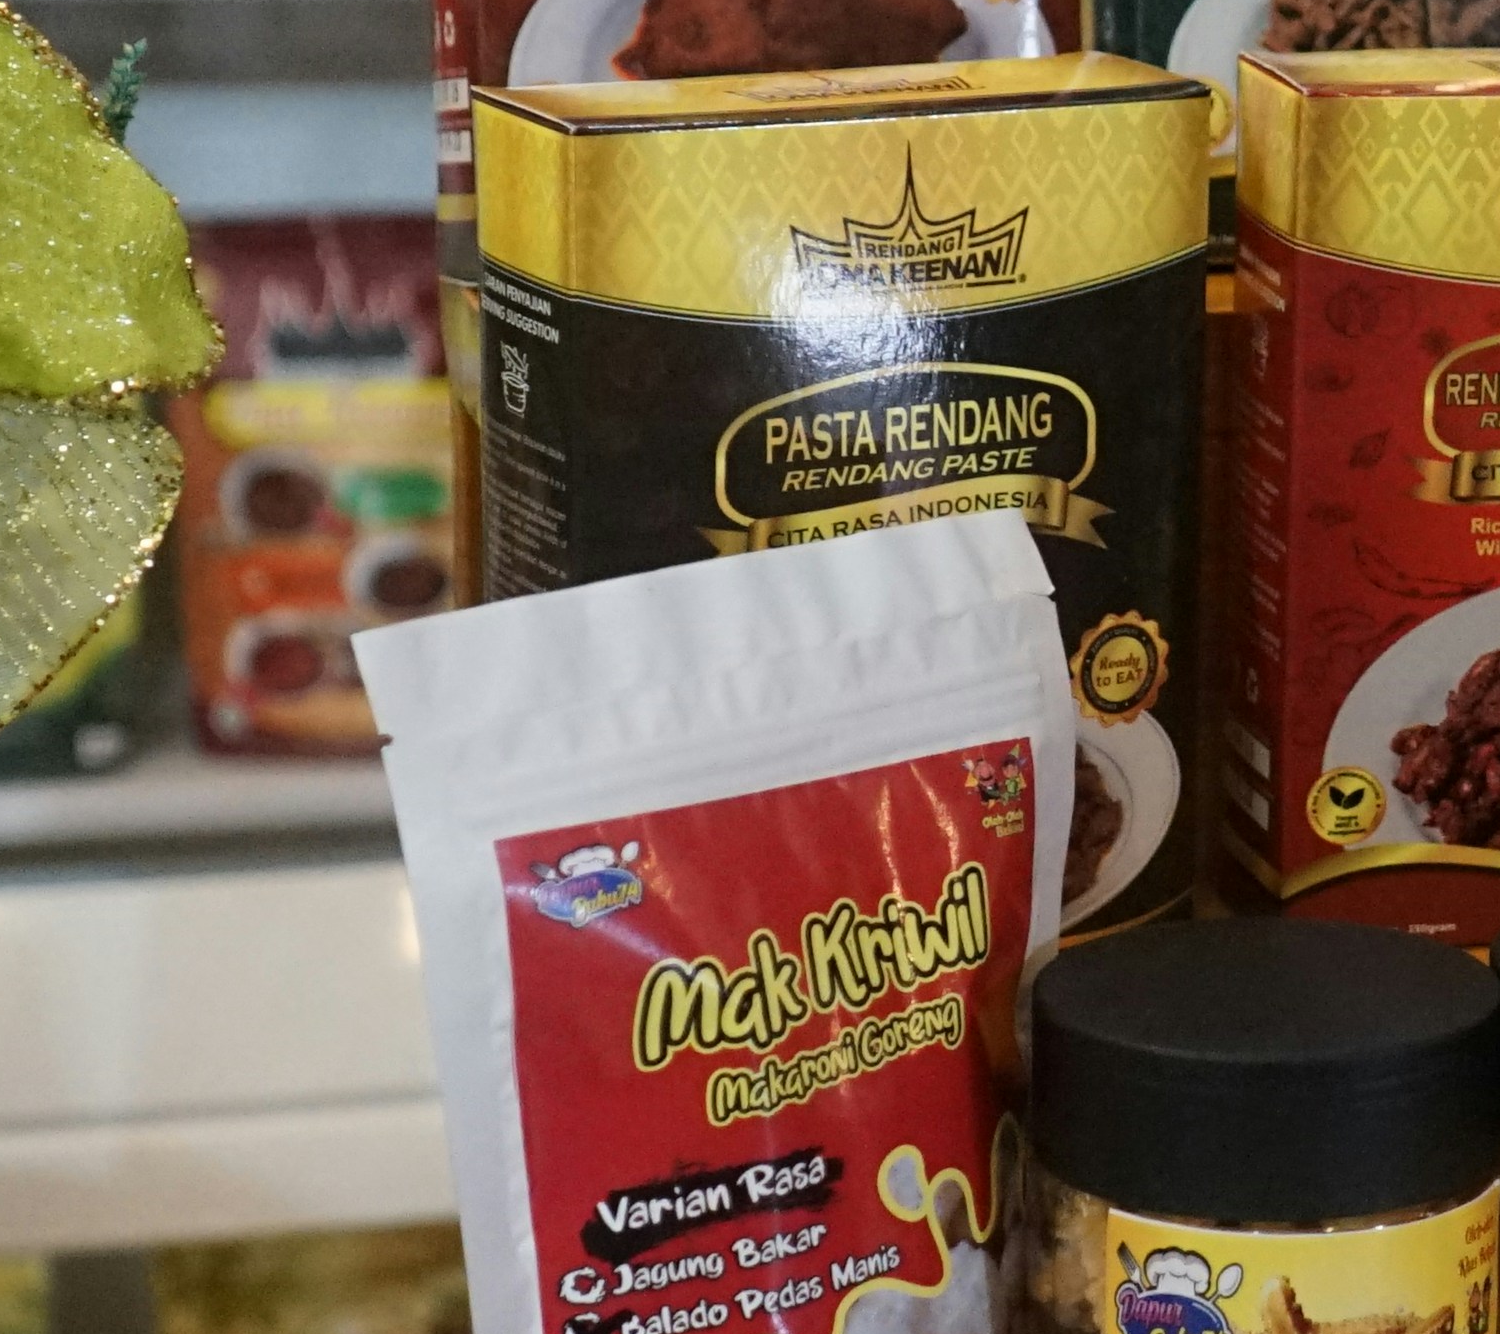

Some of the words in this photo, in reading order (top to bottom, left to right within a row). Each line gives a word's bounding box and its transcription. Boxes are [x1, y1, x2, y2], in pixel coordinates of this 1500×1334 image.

[865, 236, 956, 259] RENDANG
[889, 246, 1004, 286] KEENAN
[505, 308, 560, 345] SUGGESTION
[765, 408, 877, 465] PASTA
[885, 392, 1054, 453] RENDANG
[781, 454, 936, 493] RENDANG
[941, 446, 1038, 478] PASTE
[767, 525, 826, 549] CITA
[832, 512, 902, 541] RASA
[908, 491, 1050, 524] INDONESIA
[1096, 673, 1111, 688] to
[1116, 668, 1143, 685] EAT
[1099, 652, 1141, 672] Ready
[636, 931, 806, 1070] Mak
[803, 863, 989, 1011] Kriwil
[708, 1041, 858, 1125] Makaroni
[859, 995, 962, 1071] Goreng
[597, 1184, 731, 1235] Varian
[736, 1154, 828, 1203] Rasa
[613, 1251, 725, 1297] Jagung
[731, 1223, 828, 1271] Bakar
[740, 1278, 825, 1321] Pedas
[831, 1244, 901, 1292] Manis
[1119, 1293, 1184, 1327] Dapur
